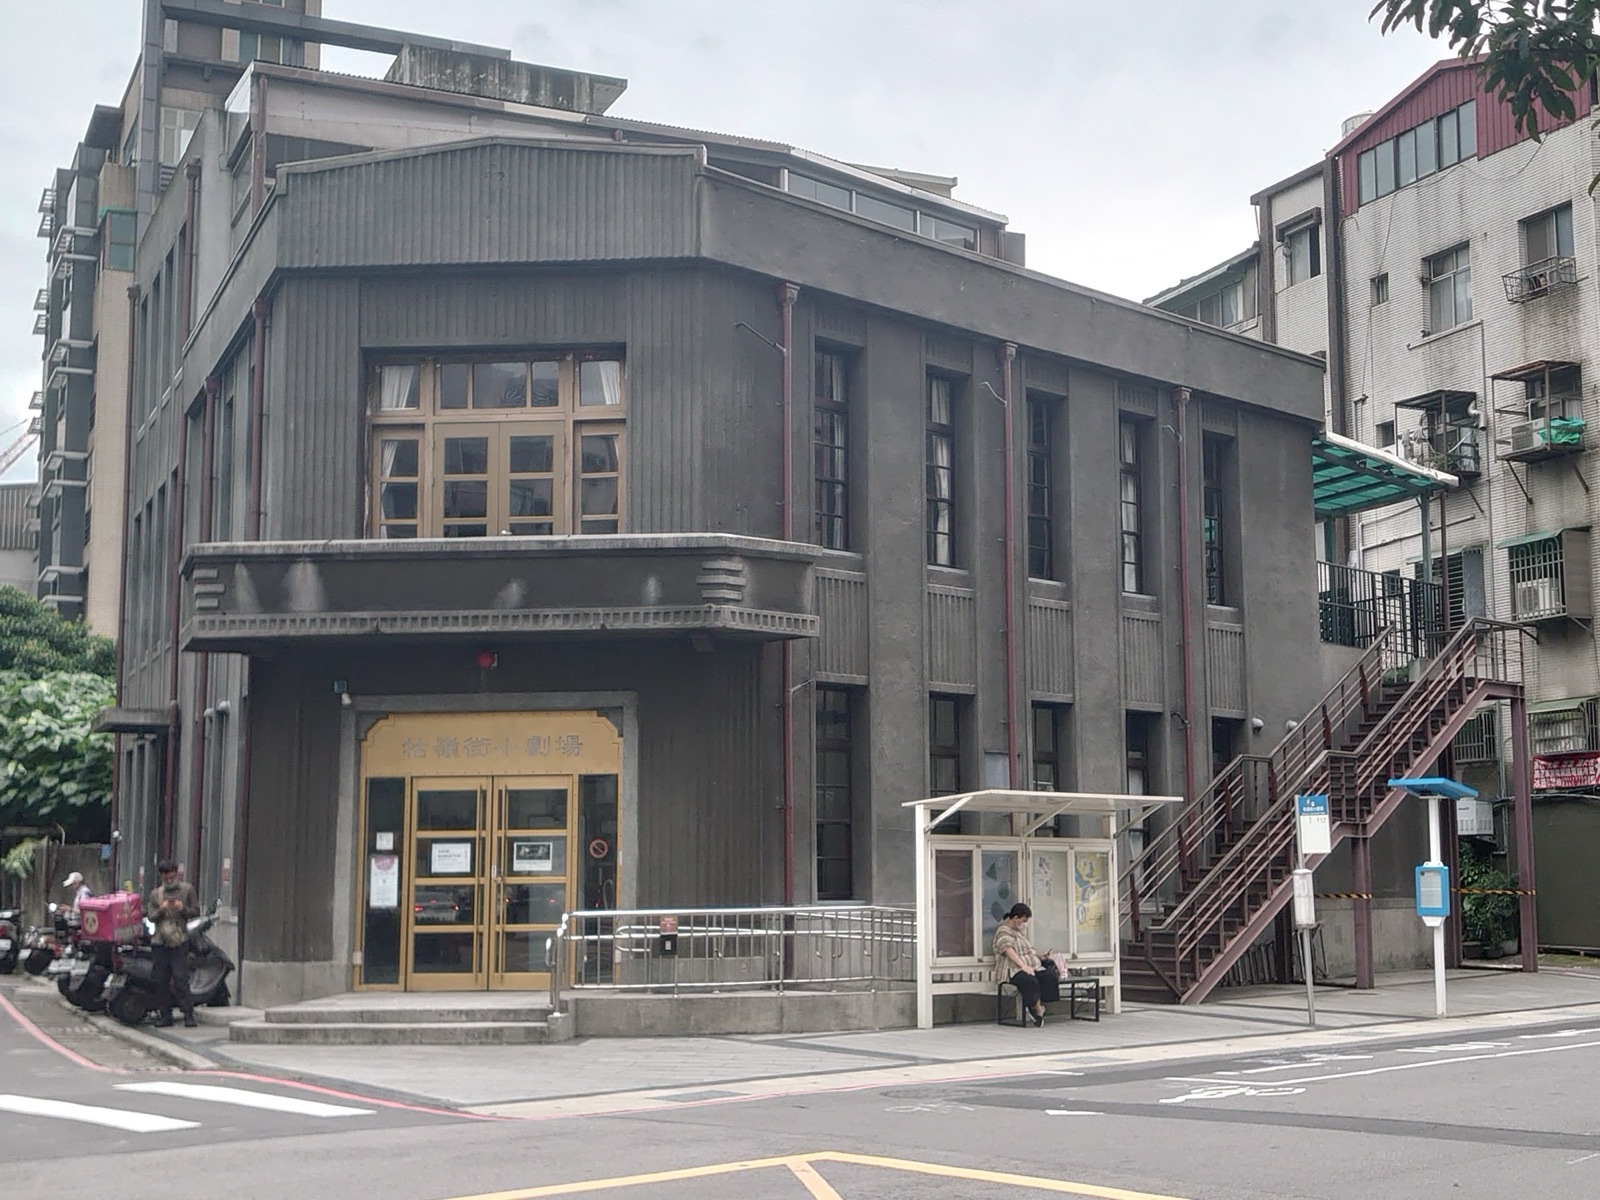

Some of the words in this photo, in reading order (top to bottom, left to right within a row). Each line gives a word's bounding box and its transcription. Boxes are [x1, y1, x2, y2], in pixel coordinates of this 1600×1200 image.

[402, 735, 583, 758] 牯嶺街小劇場
